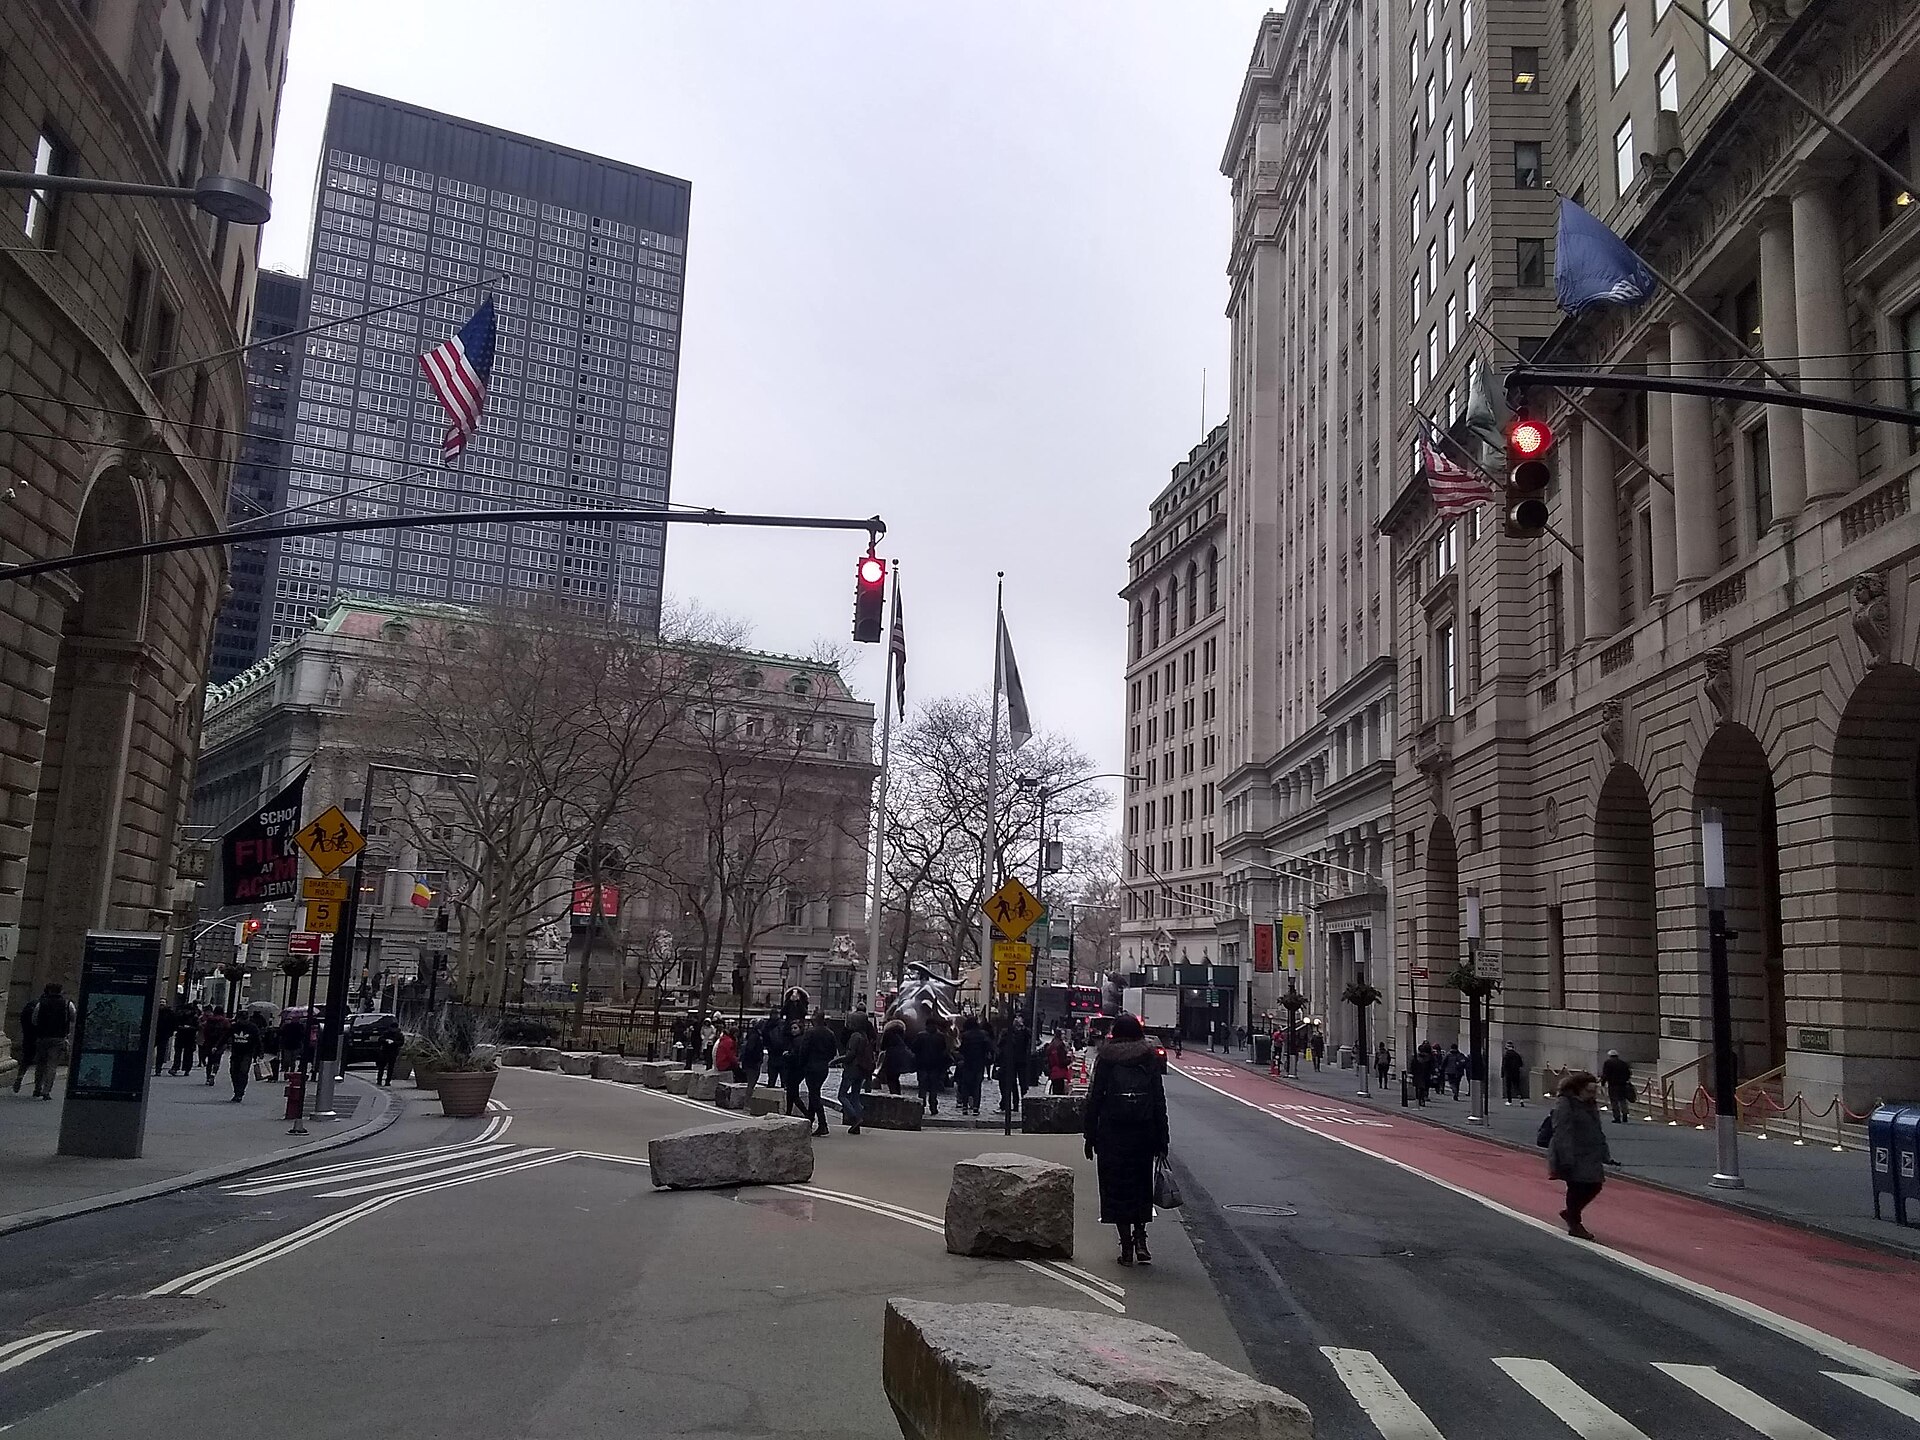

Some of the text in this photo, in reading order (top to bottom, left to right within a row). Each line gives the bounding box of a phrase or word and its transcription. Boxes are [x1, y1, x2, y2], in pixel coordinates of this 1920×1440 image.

[266, 825, 280, 837] OF
[309, 881, 329, 889] SHARE
[314, 889, 335, 897] ROAD
[316, 904, 330, 920] 5
[1007, 967, 1017, 982] 5
[1267, 1102, 1354, 1115] ONLY
[1295, 1114, 1394, 1128] BUS
